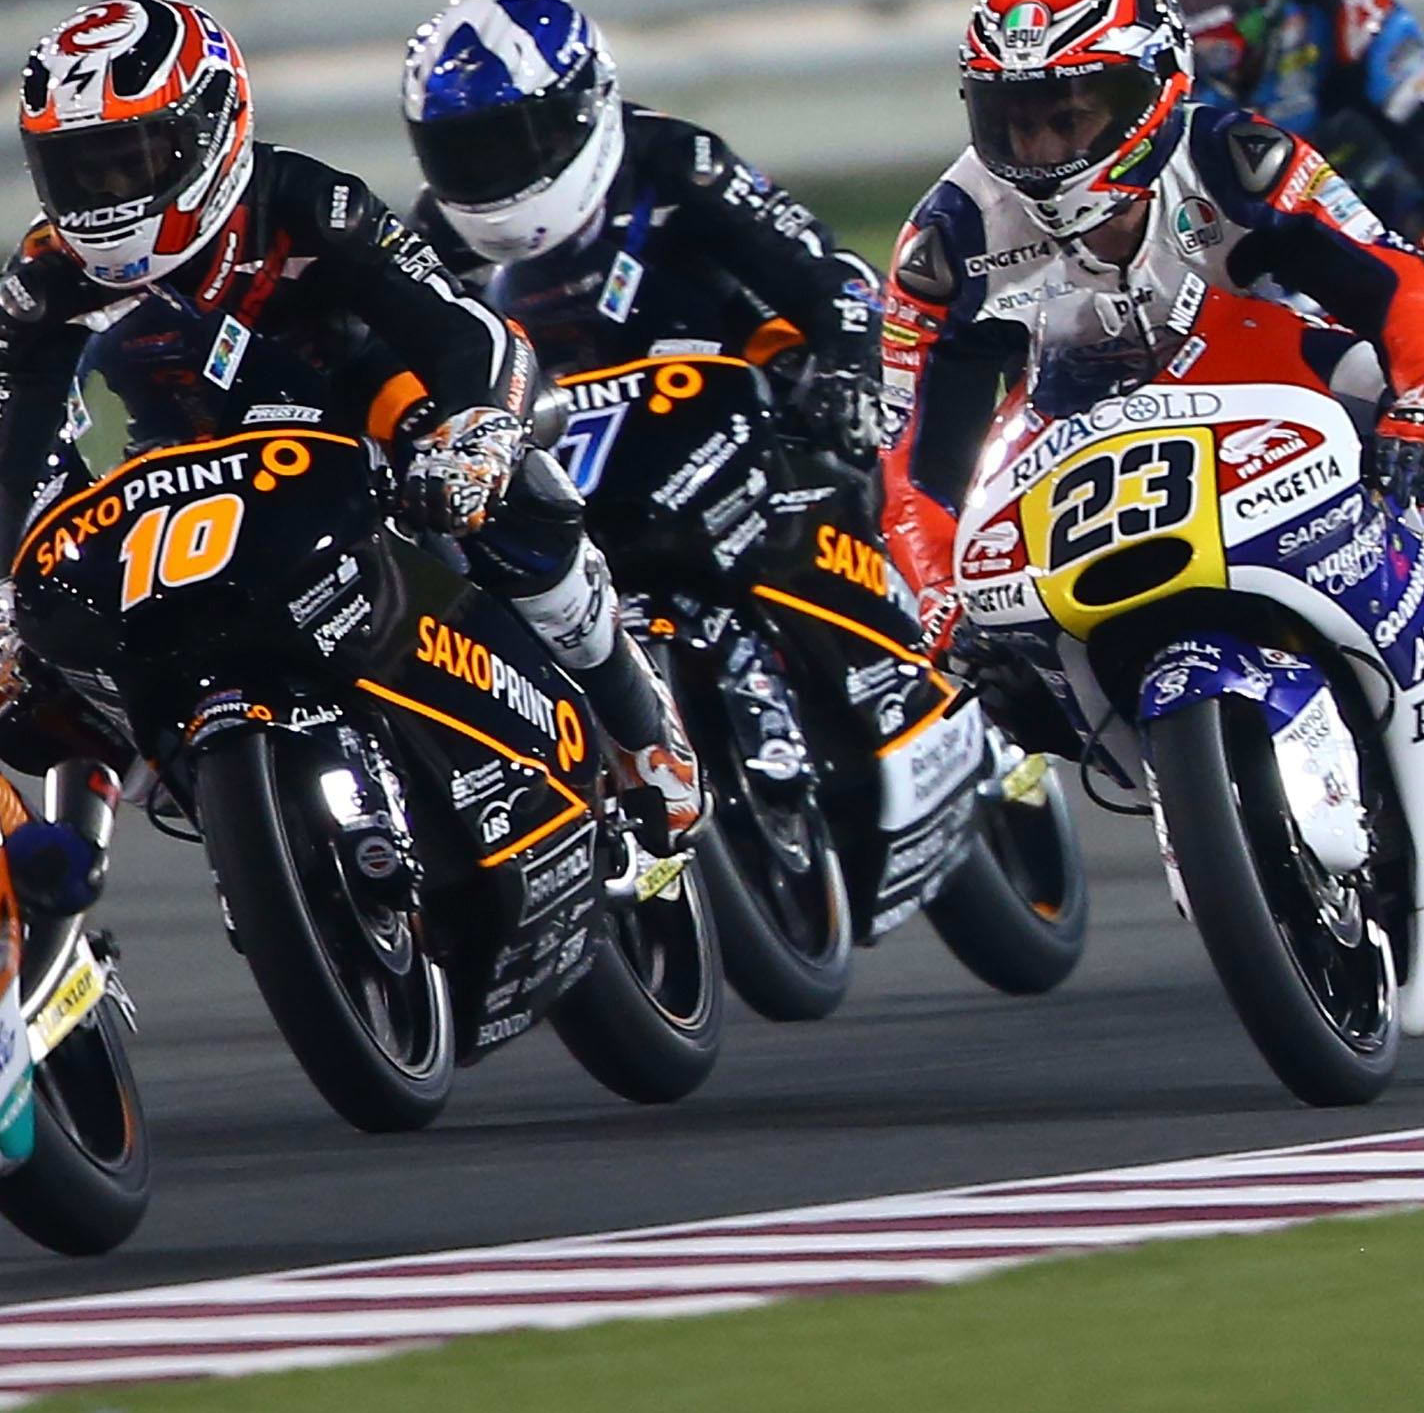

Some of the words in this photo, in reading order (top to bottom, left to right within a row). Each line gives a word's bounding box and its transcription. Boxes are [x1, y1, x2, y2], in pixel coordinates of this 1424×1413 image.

[1055, 60, 1105, 79] POLLINI
[58, 195, 155, 228] MOST
[967, 242, 1051, 276] ONGETTA
[834, 298, 868, 332] rsf
[1166, 272, 1208, 336] NICCO
[1009, 391, 1223, 492] RIVACOLD
[1262, 437, 1308, 468] ITALIA
[36, 452, 250, 577] SAXOPRINT
[1048, 434, 1200, 576] 23
[1236, 454, 1343, 522] ONGETTA
[118, 492, 246, 613] 10
[415, 614, 558, 743] SAXOPRINT
